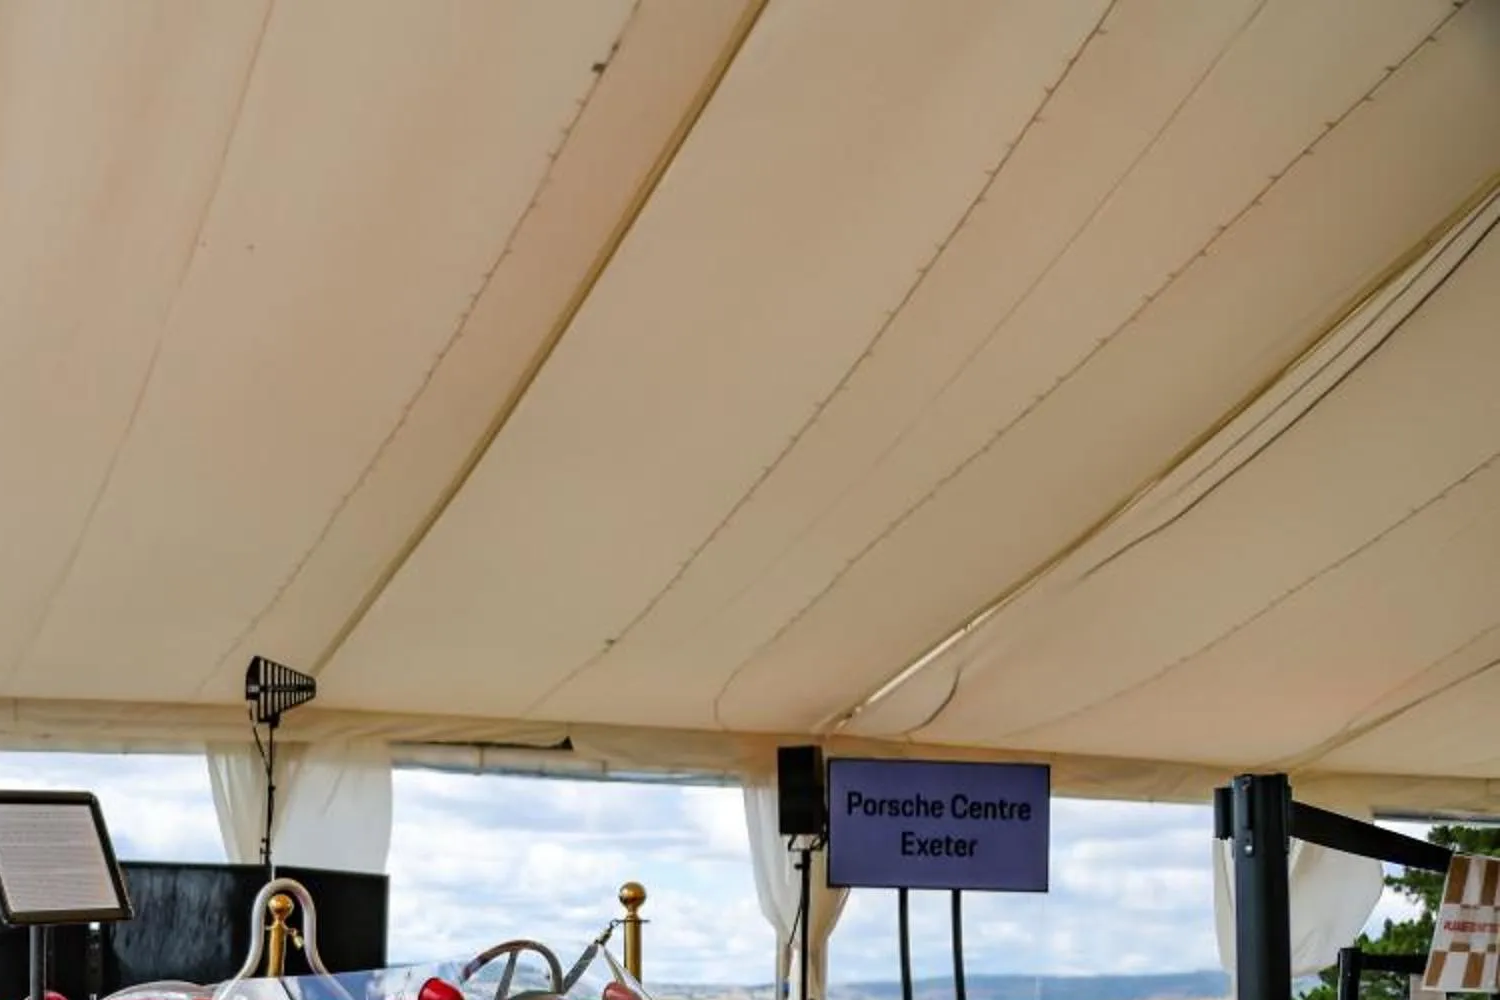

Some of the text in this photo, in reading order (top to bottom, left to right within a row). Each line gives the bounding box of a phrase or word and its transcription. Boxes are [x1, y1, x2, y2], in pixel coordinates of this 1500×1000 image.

[846, 791, 1033, 821] Porsche Centre
[900, 831, 979, 858] Exeter
